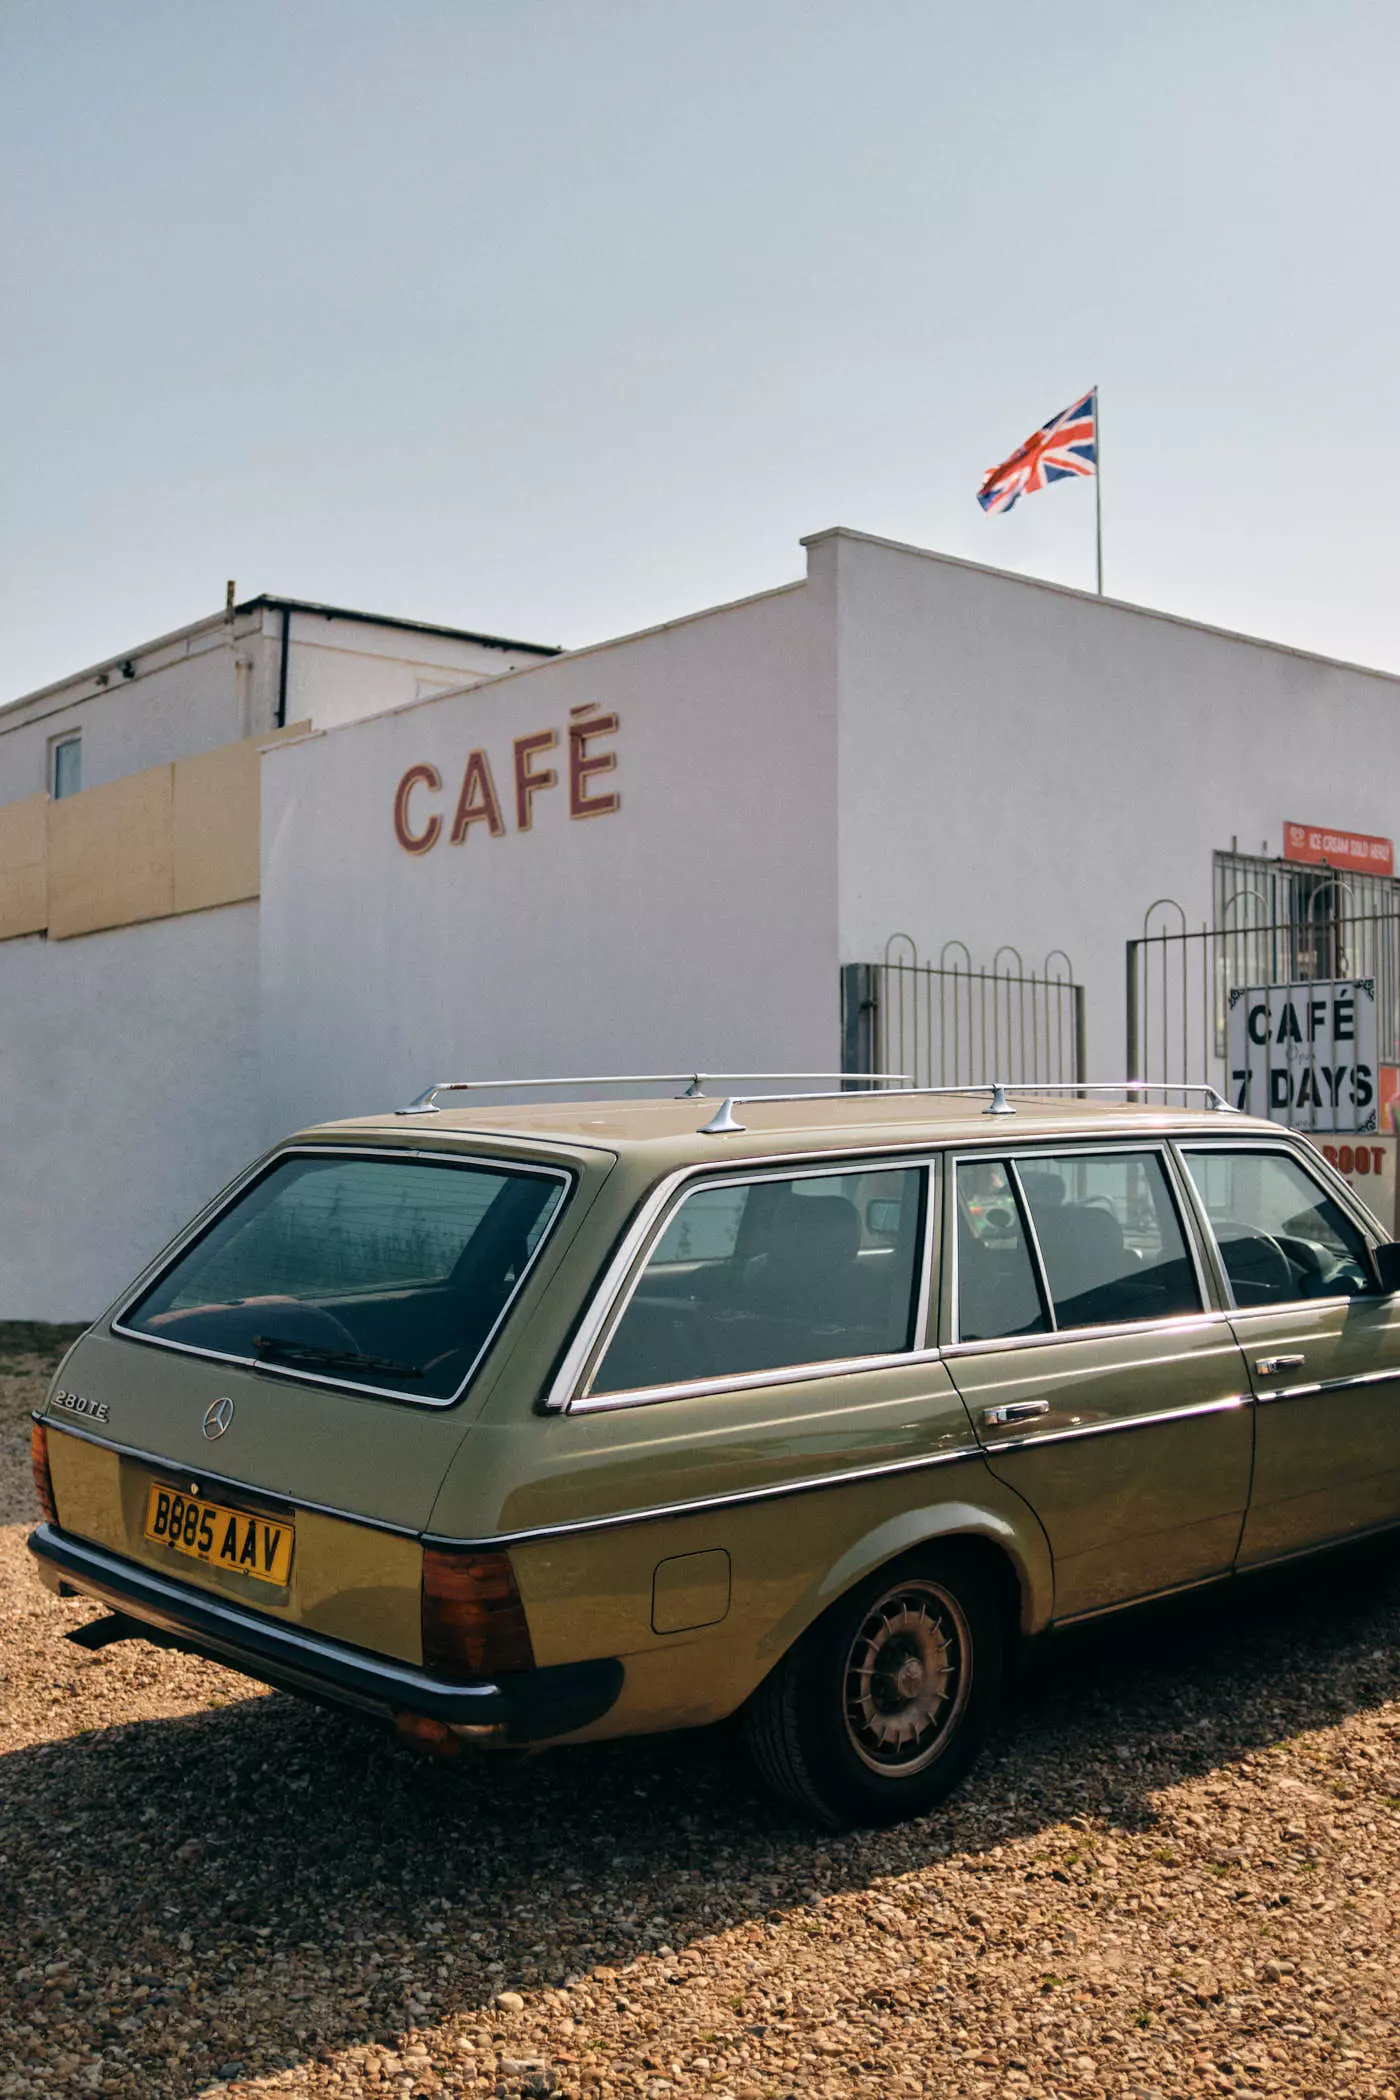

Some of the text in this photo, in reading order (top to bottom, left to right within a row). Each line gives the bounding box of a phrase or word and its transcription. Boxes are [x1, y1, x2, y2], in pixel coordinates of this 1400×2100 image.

[393, 701, 620, 856] CAFÉ
[1309, 833, 1322, 850] ICE
[1248, 989, 1356, 1046] CAFÉ
[1232, 1064, 1374, 1111] 7 DAYS
[153, 1492, 282, 1572] B885 AAV
